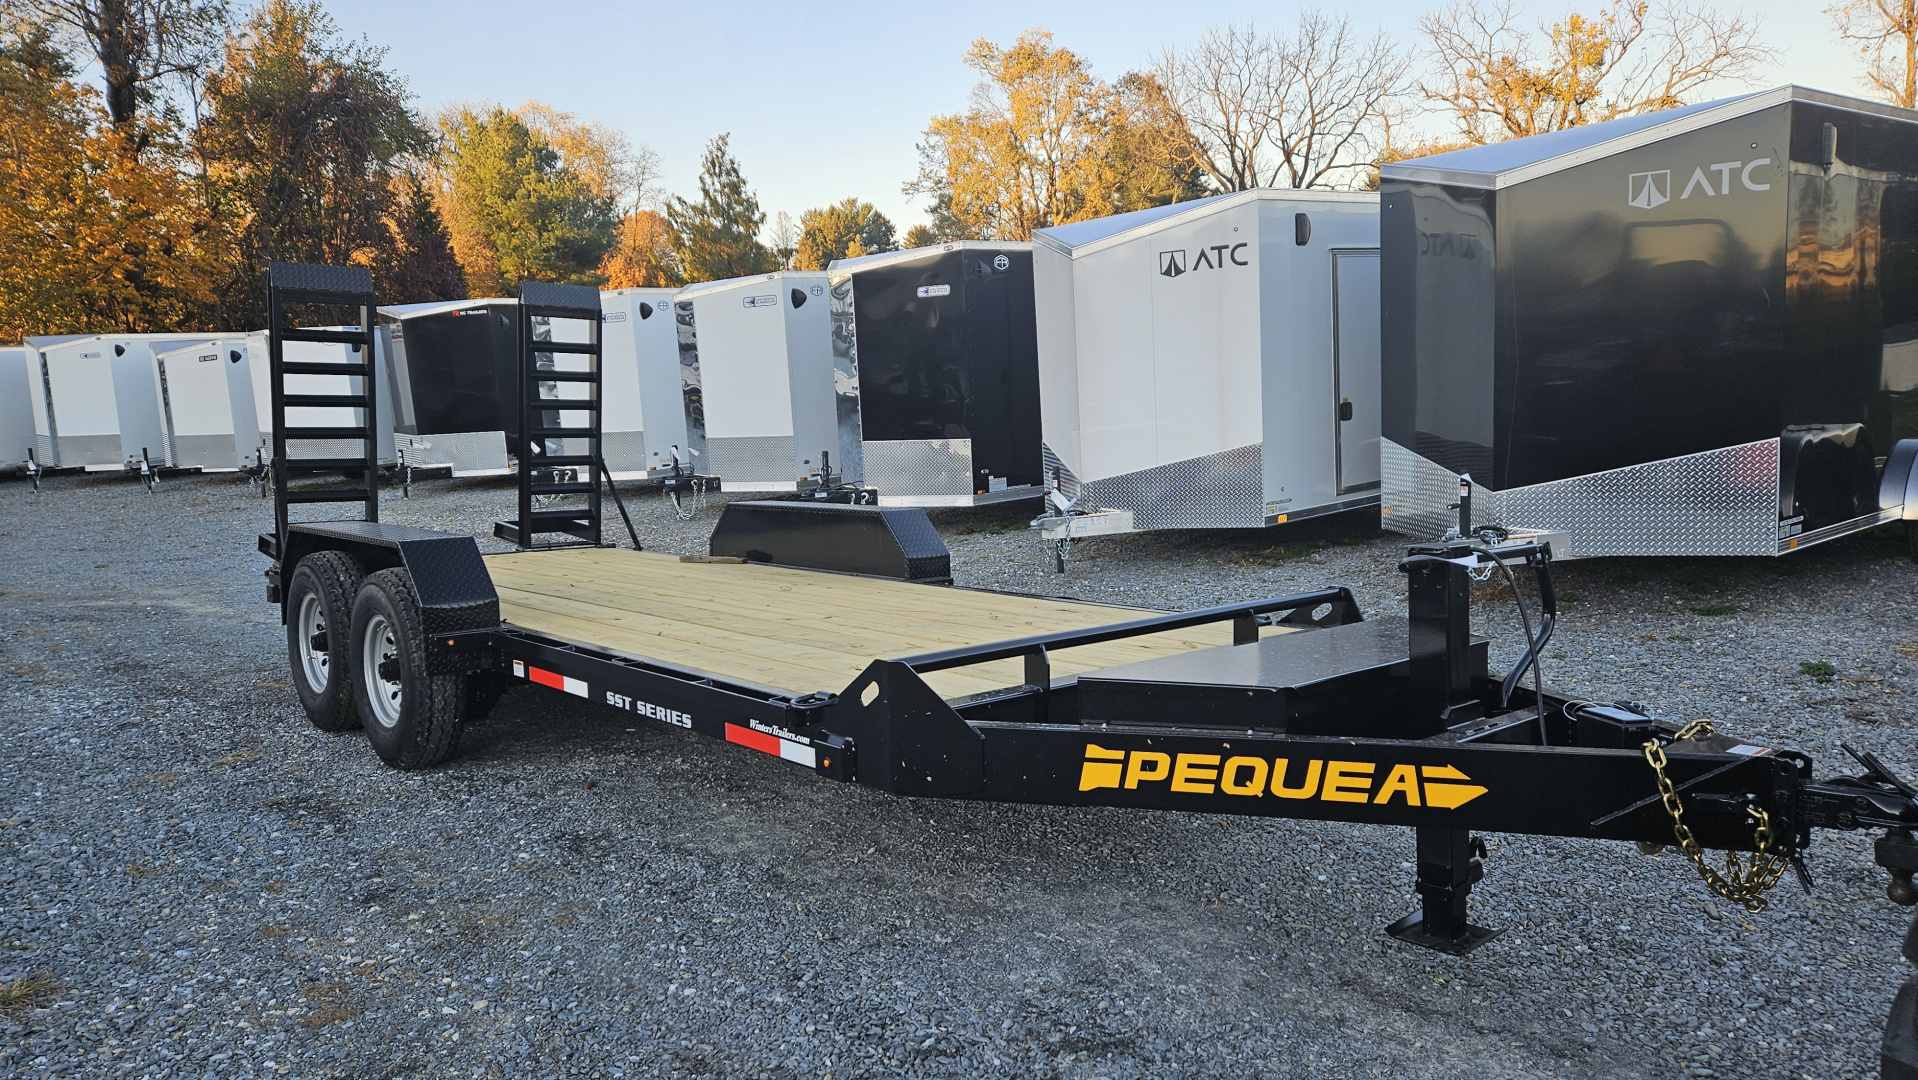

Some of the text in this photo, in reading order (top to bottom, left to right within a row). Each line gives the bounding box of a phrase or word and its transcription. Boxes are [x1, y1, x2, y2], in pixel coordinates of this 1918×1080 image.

[1680, 157, 1771, 200] ATC
[1192, 242, 1248, 271] ATC
[606, 690, 692, 729] SST SERIES
[1123, 750, 1422, 807] PEQUEA
